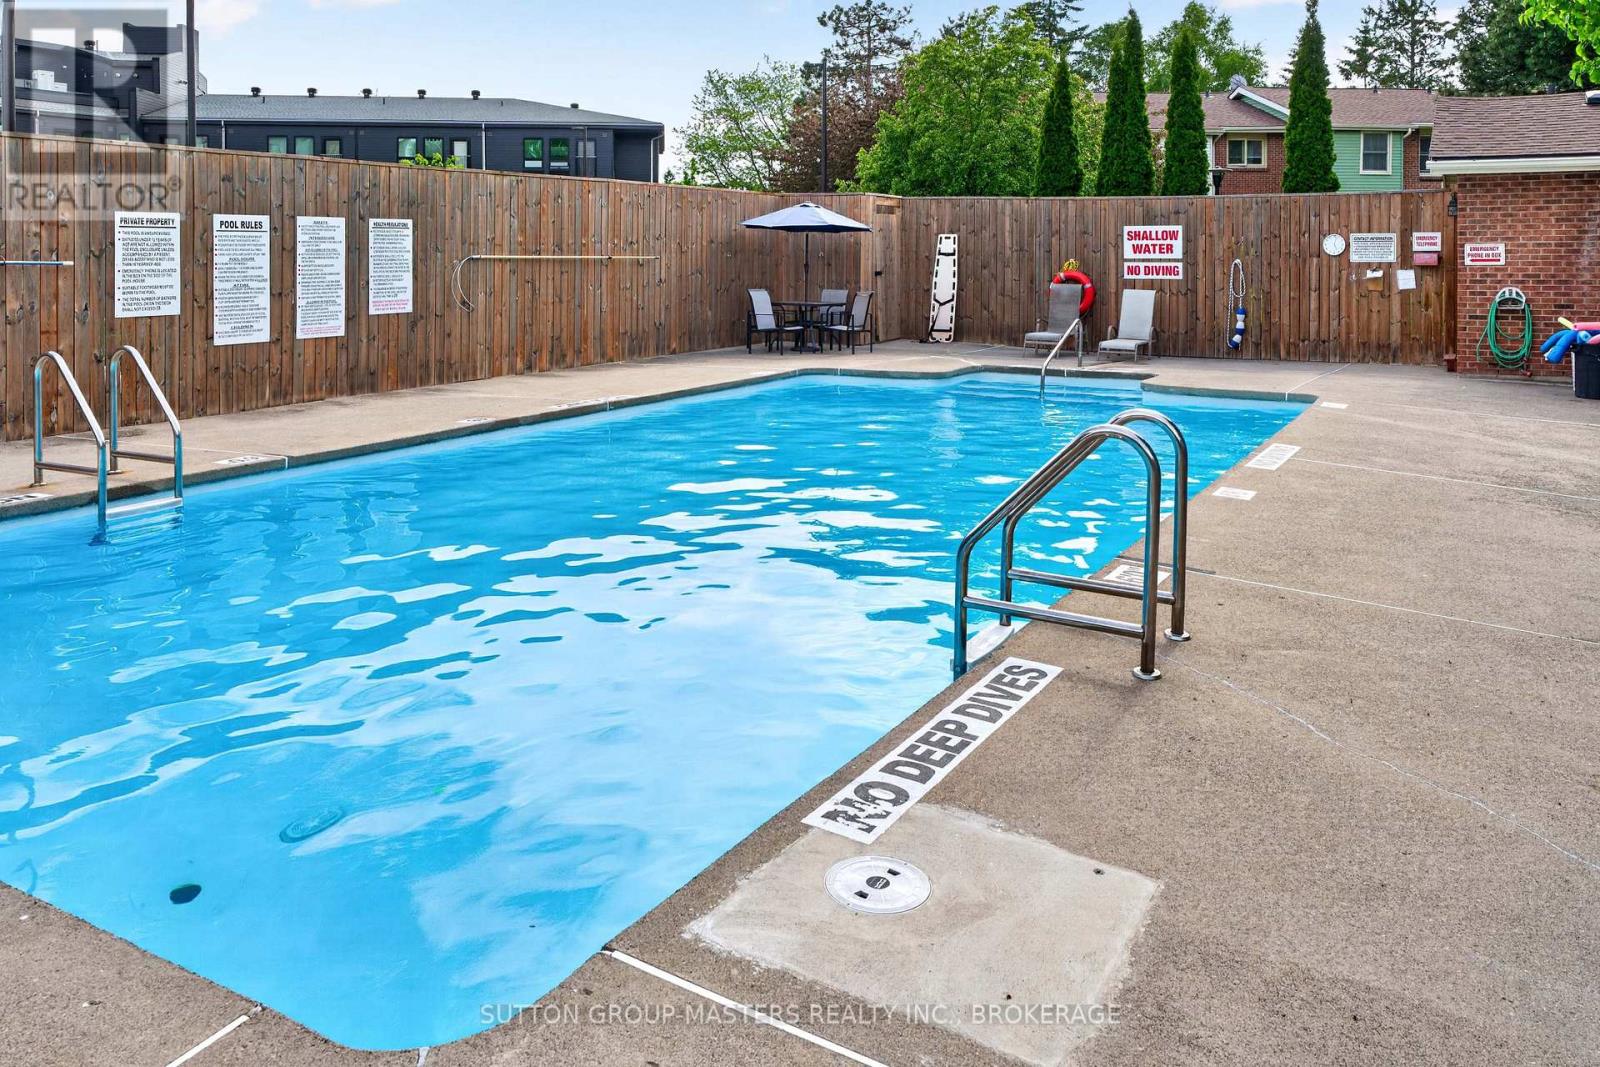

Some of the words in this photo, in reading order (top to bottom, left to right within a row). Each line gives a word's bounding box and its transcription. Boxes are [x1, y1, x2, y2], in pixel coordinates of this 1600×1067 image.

[120, 217, 145, 225] PRIVATE
[146, 217, 175, 226] PROPERTY
[220, 221, 239, 229] POOL
[240, 221, 263, 230] RULES
[1127, 230, 1179, 241] SHALLOW
[1132, 243, 1174, 254] WATER
[1127, 265, 1140, 276] NO
[1143, 265, 1180, 276] DIVING
[821, 781, 910, 834] NO
[880, 719, 980, 784] DEEP
[952, 664, 1048, 724] DIVES
